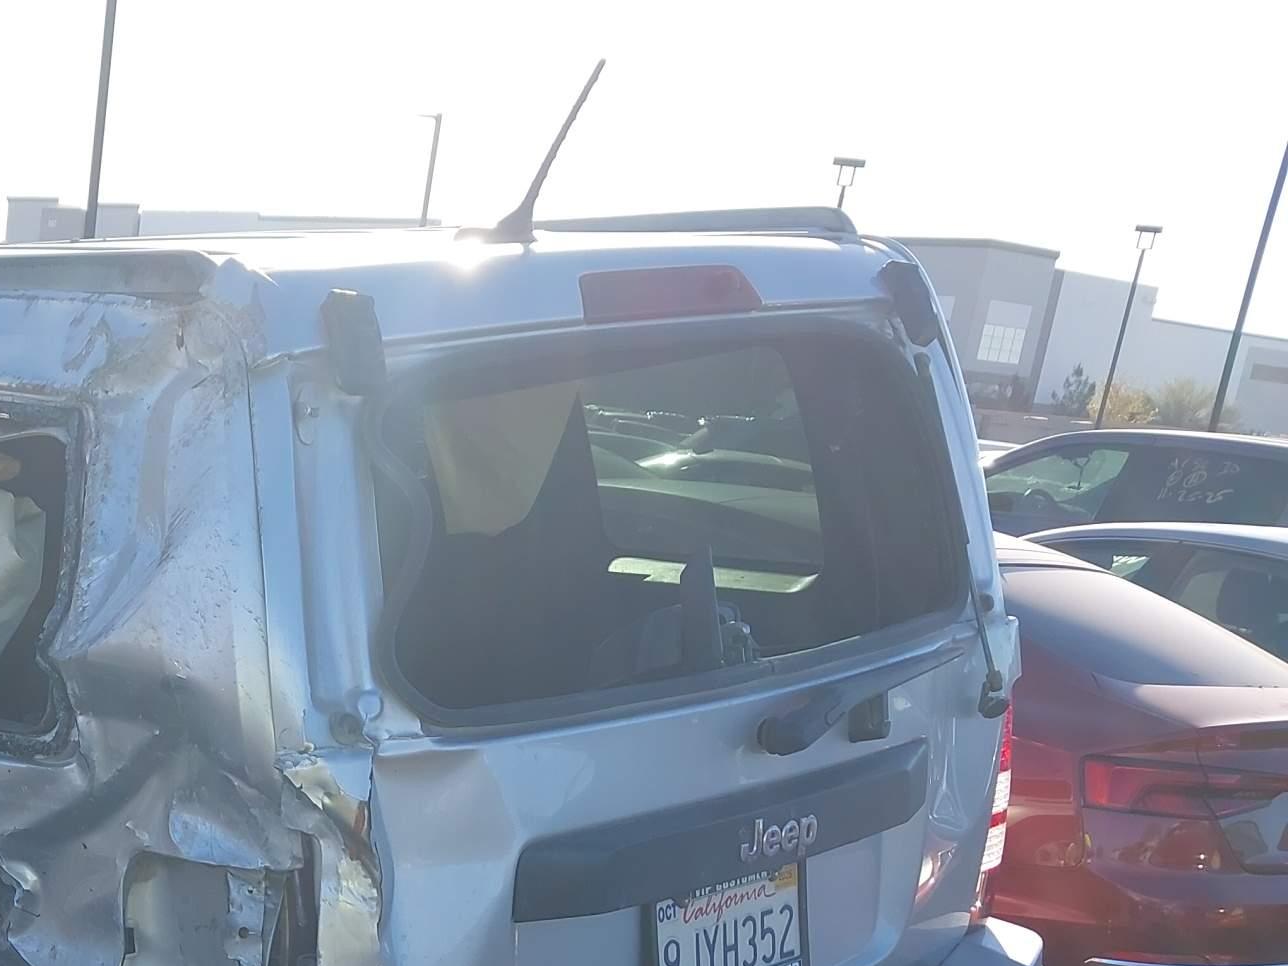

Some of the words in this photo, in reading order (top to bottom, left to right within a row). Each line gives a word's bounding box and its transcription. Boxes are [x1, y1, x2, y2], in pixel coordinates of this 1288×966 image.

[740, 814, 818, 862] Jeep
[658, 903, 677, 923] OCT
[681, 884, 776, 924] California
